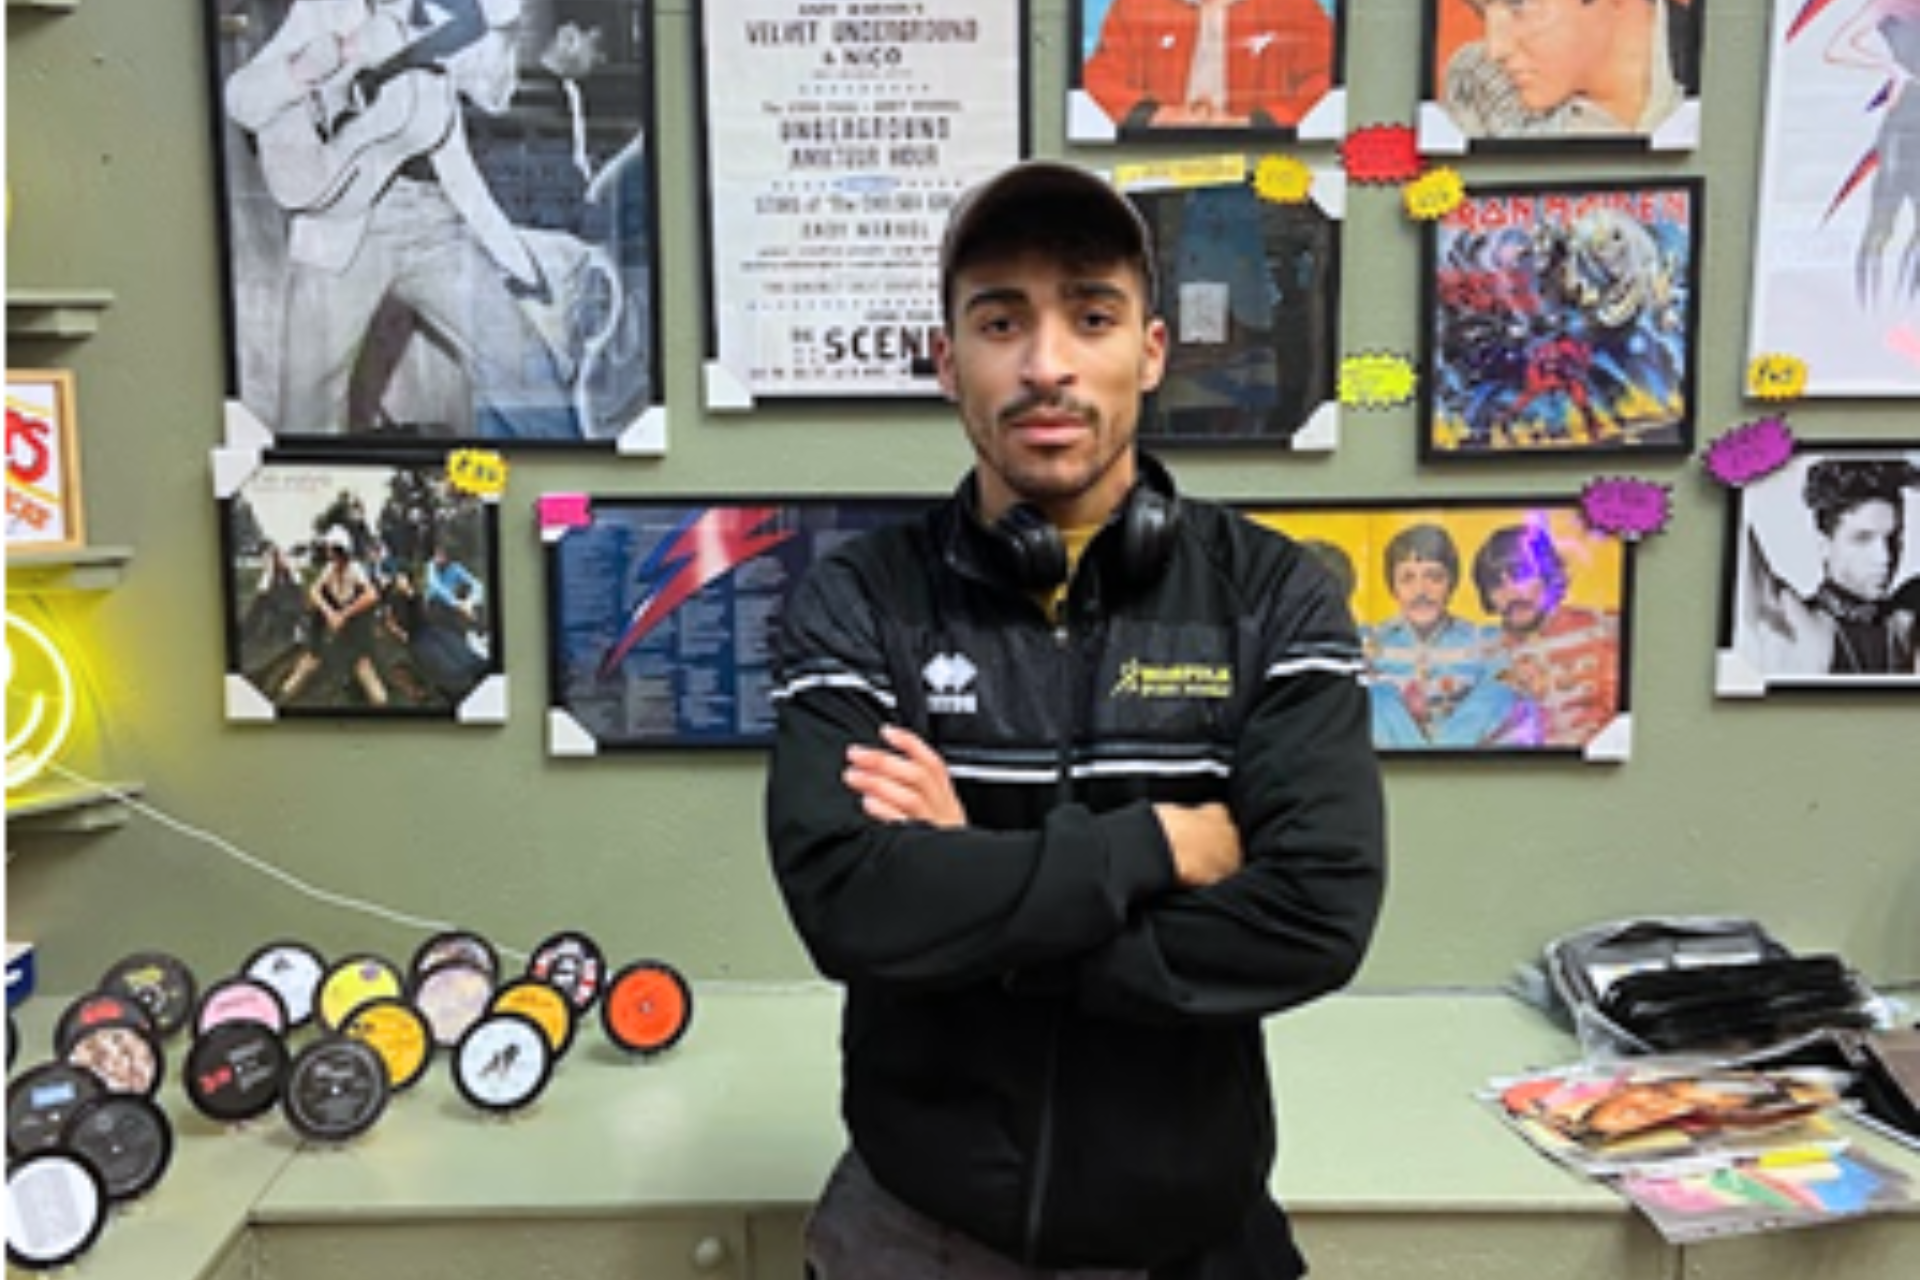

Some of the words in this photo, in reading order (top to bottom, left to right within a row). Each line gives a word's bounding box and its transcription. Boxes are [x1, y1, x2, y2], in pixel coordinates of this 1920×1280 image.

[745, 20, 818, 45] VELVET
[832, 19, 978, 43] UNDERGROUND
[843, 47, 903, 67] NICO
[781, 117, 950, 141] UNDERGROUND
[889, 147, 939, 167] HOUR
